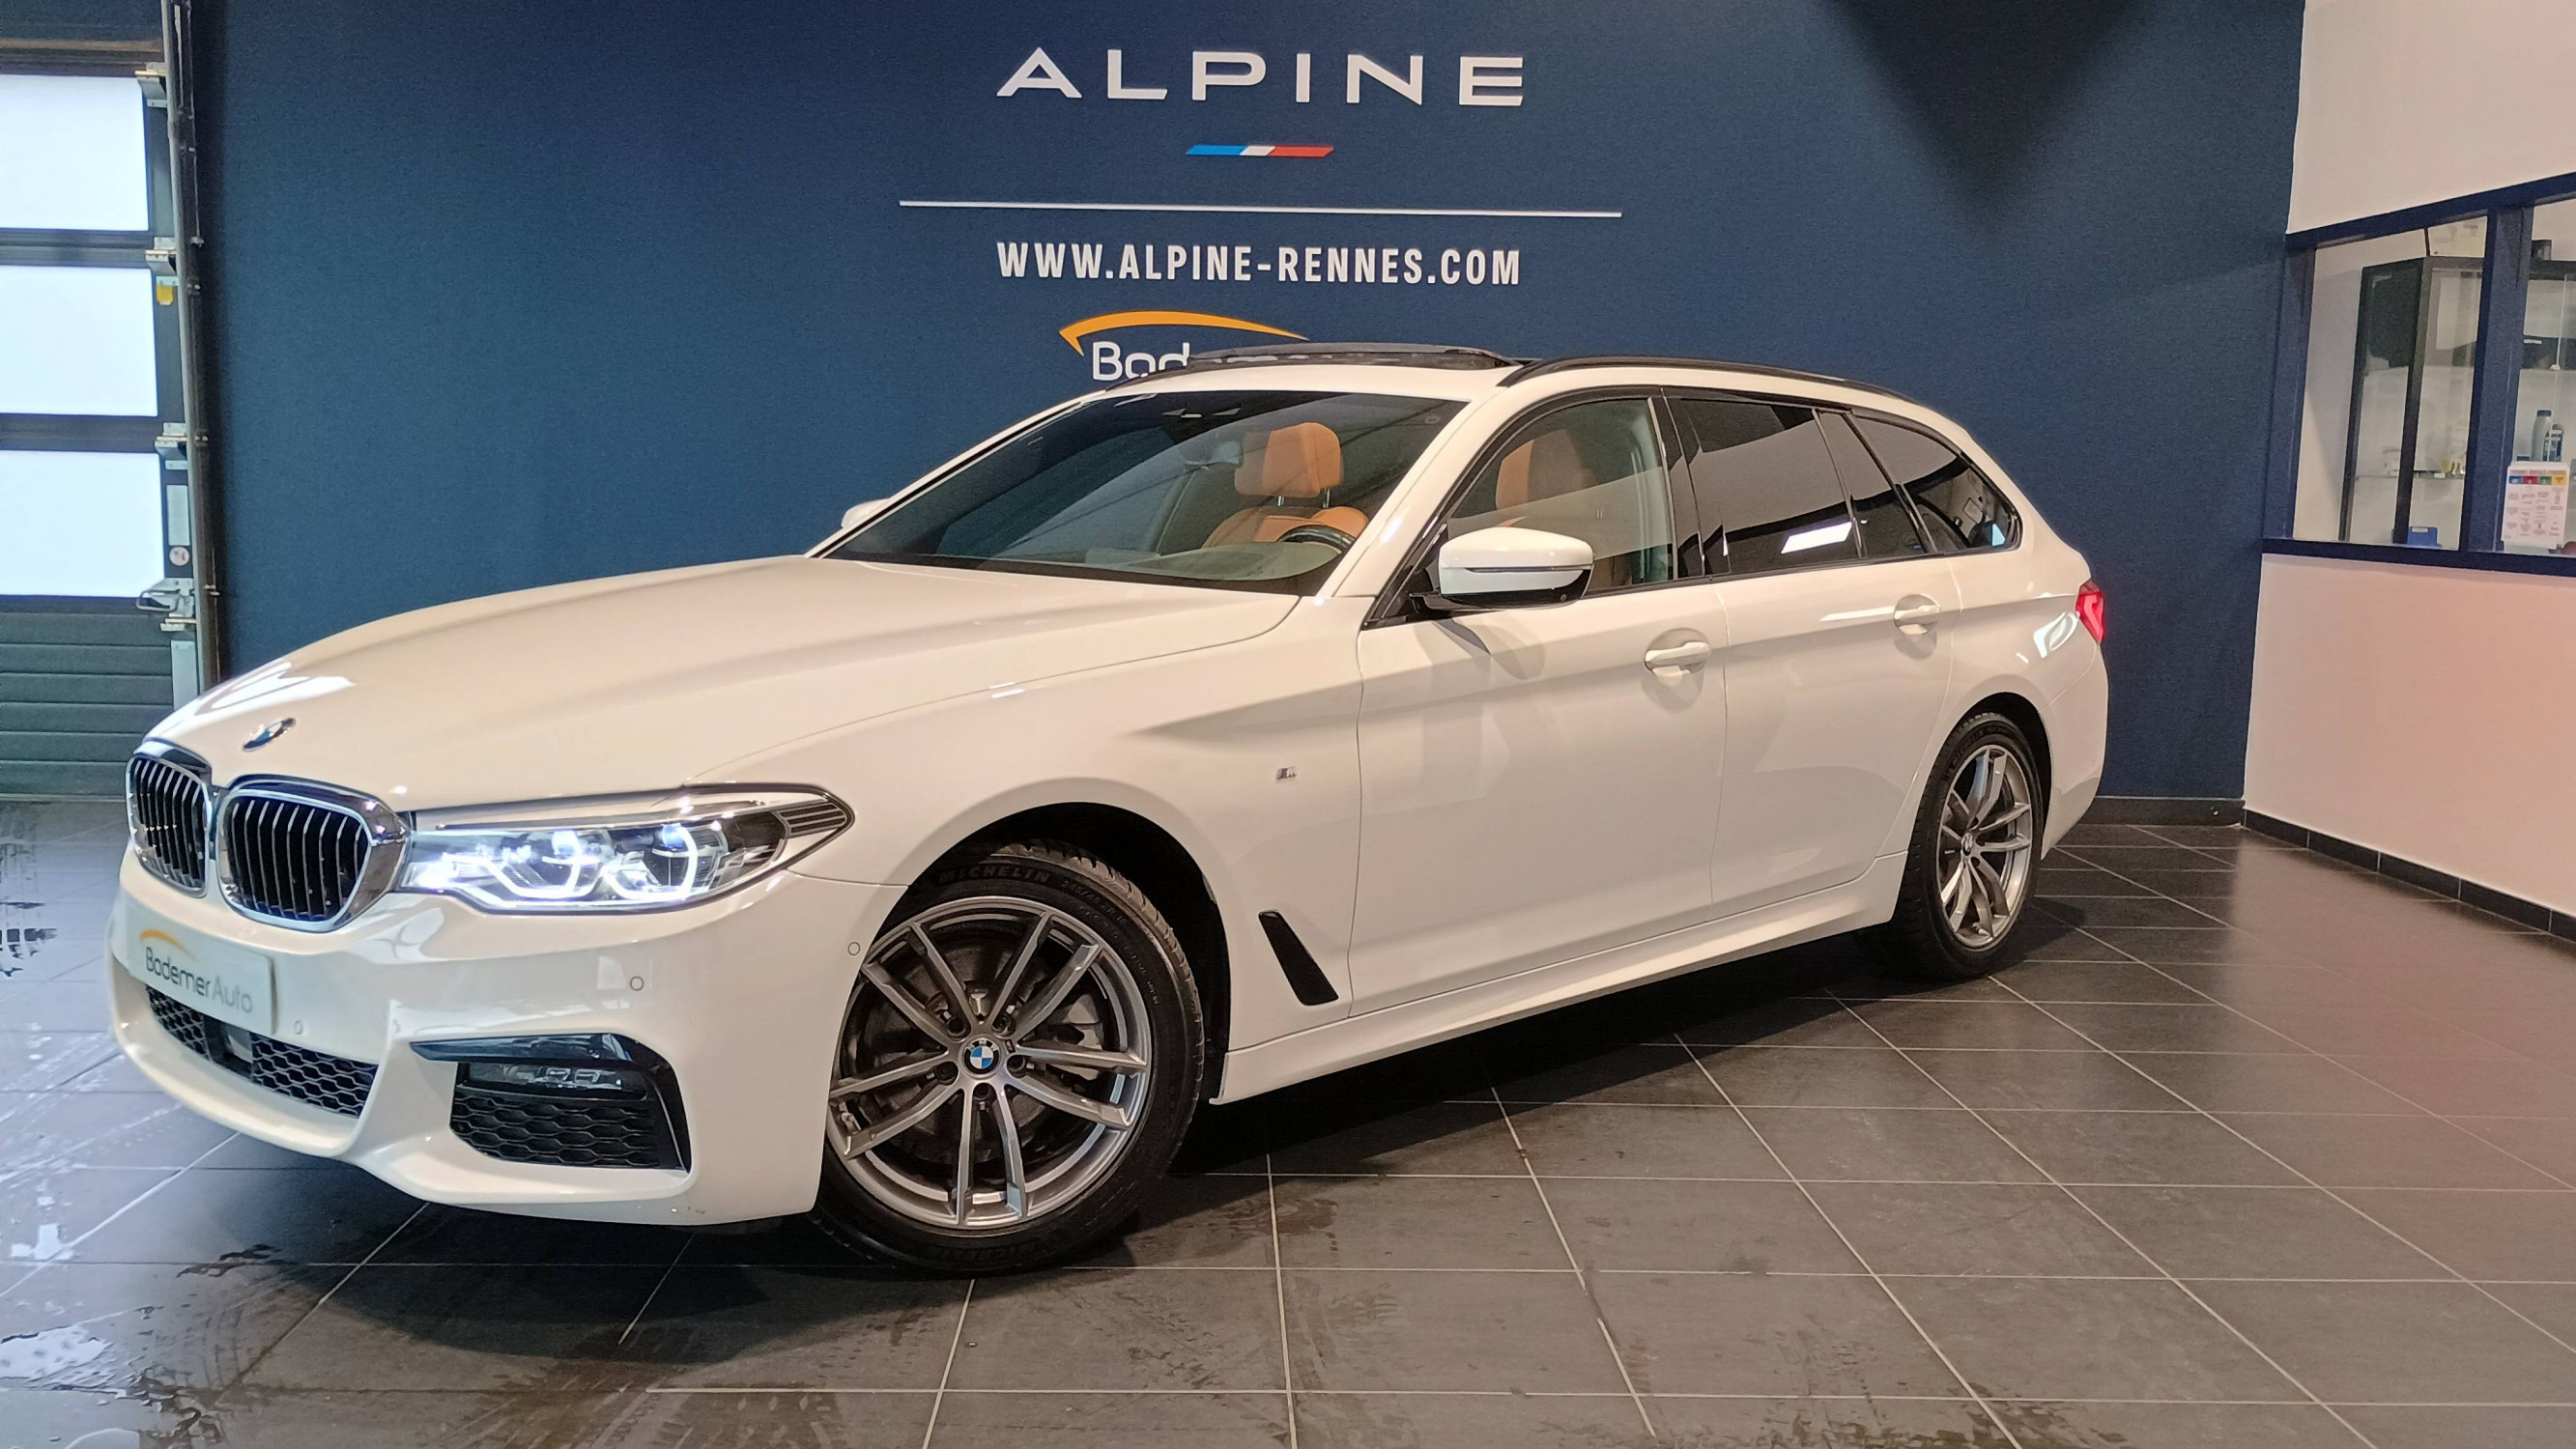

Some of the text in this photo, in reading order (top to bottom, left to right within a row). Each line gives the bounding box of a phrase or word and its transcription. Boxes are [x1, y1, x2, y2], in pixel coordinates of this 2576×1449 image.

[996, 47, 1525, 107] ALPINE
[996, 242, 1521, 286] WWW.ALPINE-RENNES.COM
[1093, 341, 1190, 382] Bod
[937, 863, 1051, 884] MICHELIN
